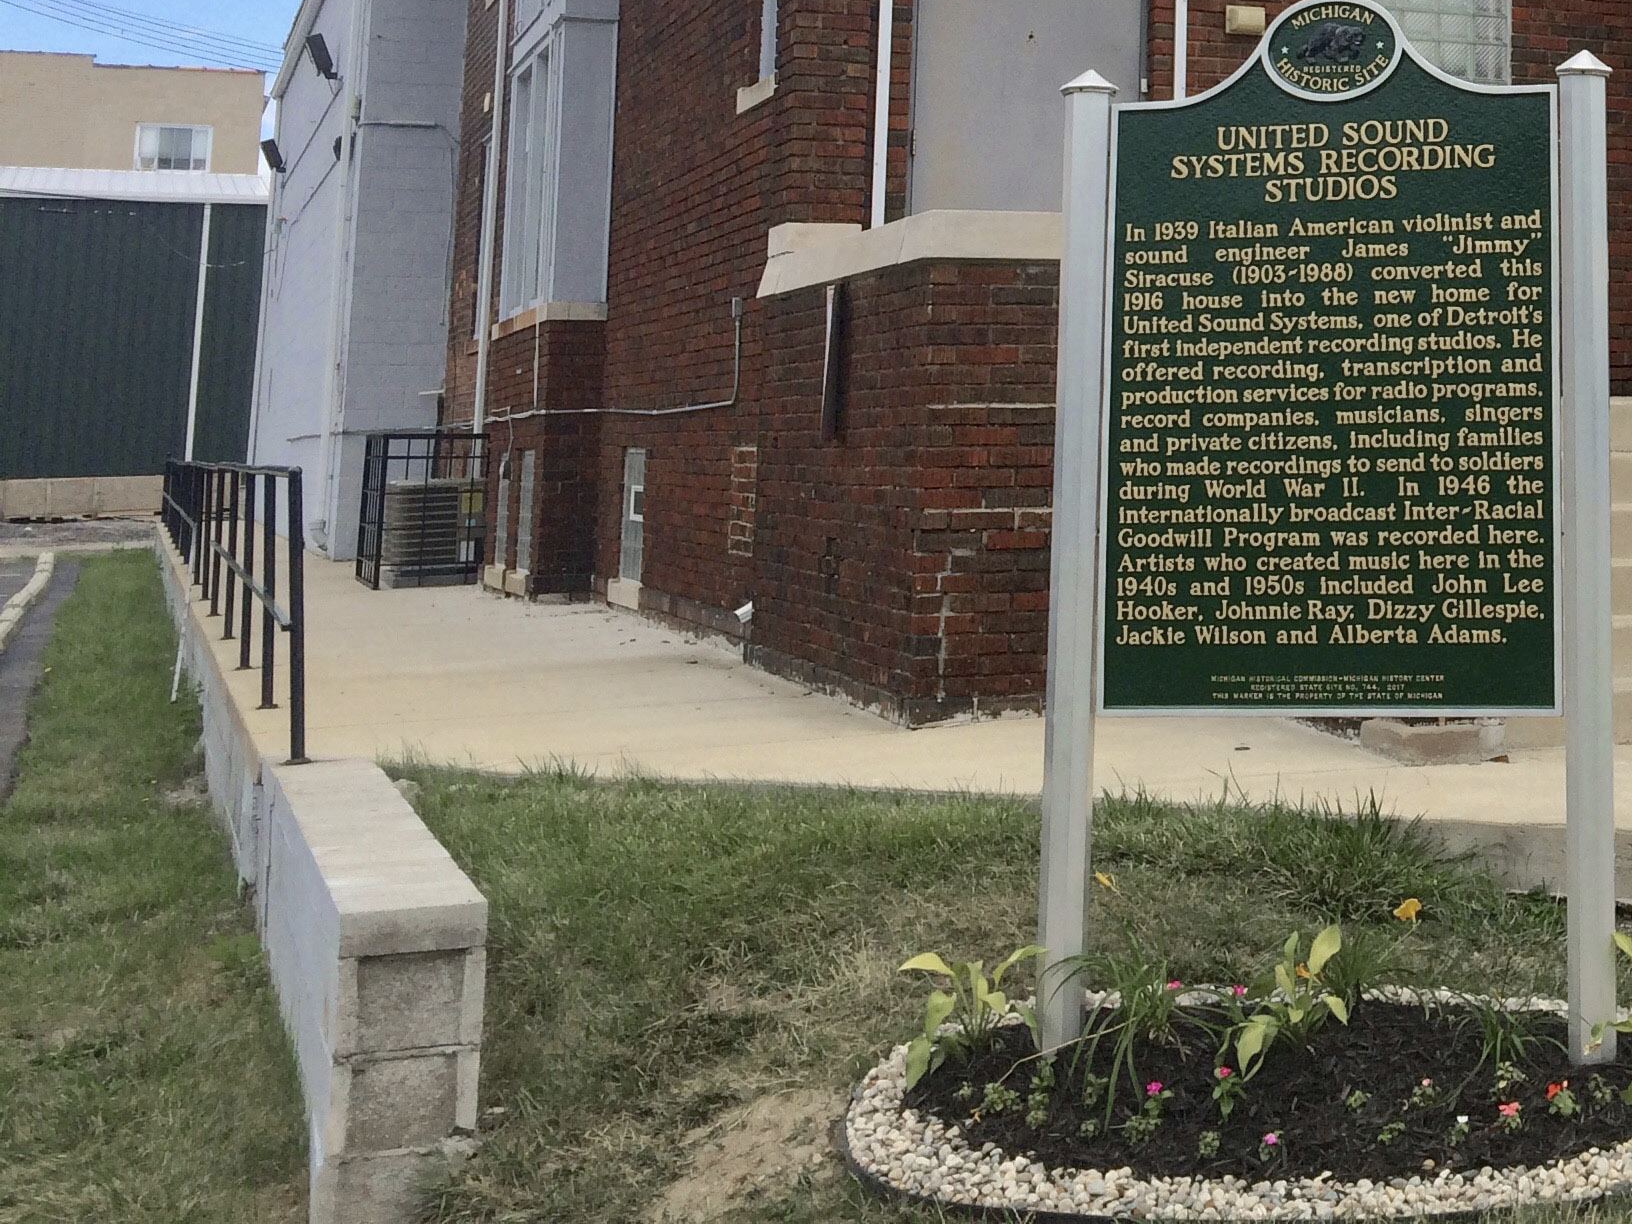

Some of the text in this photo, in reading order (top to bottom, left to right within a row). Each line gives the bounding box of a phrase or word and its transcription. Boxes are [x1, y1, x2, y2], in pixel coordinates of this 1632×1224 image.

[1291, 5, 1375, 29] MICHIGAN
[1276, 54, 1389, 91] HISTORIC SITE
[1303, 65, 1361, 73] REGISTERED
[1217, 118, 1448, 151] UNITED SOUND
[1171, 144, 1495, 180] SYSTEMS RECORDING
[1265, 175, 1397, 203] STUDIOS
[1125, 209, 1542, 242] In 1939 Italian American violinist and
[1124, 244, 1188, 265] sound
[1215, 242, 1310, 266] engineer
[1341, 238, 1409, 258] James
[1124, 269, 1214, 288] Siracuse
[1371, 258, 1483, 281] converted
[1499, 258, 1543, 277] this
[1123, 281, 1543, 311] 1916 house into the new home for
[1123, 314, 1193, 335] United
[1198, 311, 1265, 333] Sound
[1269, 310, 1364, 334] Systems,
[1373, 313, 1413, 328] one
[1417, 307, 1443, 327] of
[1122, 328, 1543, 360] first independent recording studios. He
[1121, 352, 1543, 382] offered recording, transcription and
[1121, 380, 1543, 410] production services for radio programs,
[1120, 403, 1543, 432] record companies, musicians, singers
[1119, 426, 1544, 456] and private citizens, including families
[1119, 451, 1544, 478] who made recordings to send to soldiers
[1119, 474, 1544, 503] during World War II. In 1946 the
[1118, 499, 1544, 525] internationally broadcast Inter-Racial
[1117, 524, 1545, 552] Goodwill Program was recorded here.
[1117, 548, 1544, 573] Artists who created music here in the
[1117, 572, 1544, 597] 1940s and 1950s included John Lee
[1116, 598, 1545, 624] Hooker, Johnnie Ray, Dizzy Gillespie,
[1115, 623, 1507, 645] Jackie Wilson and Alberta Adams.
